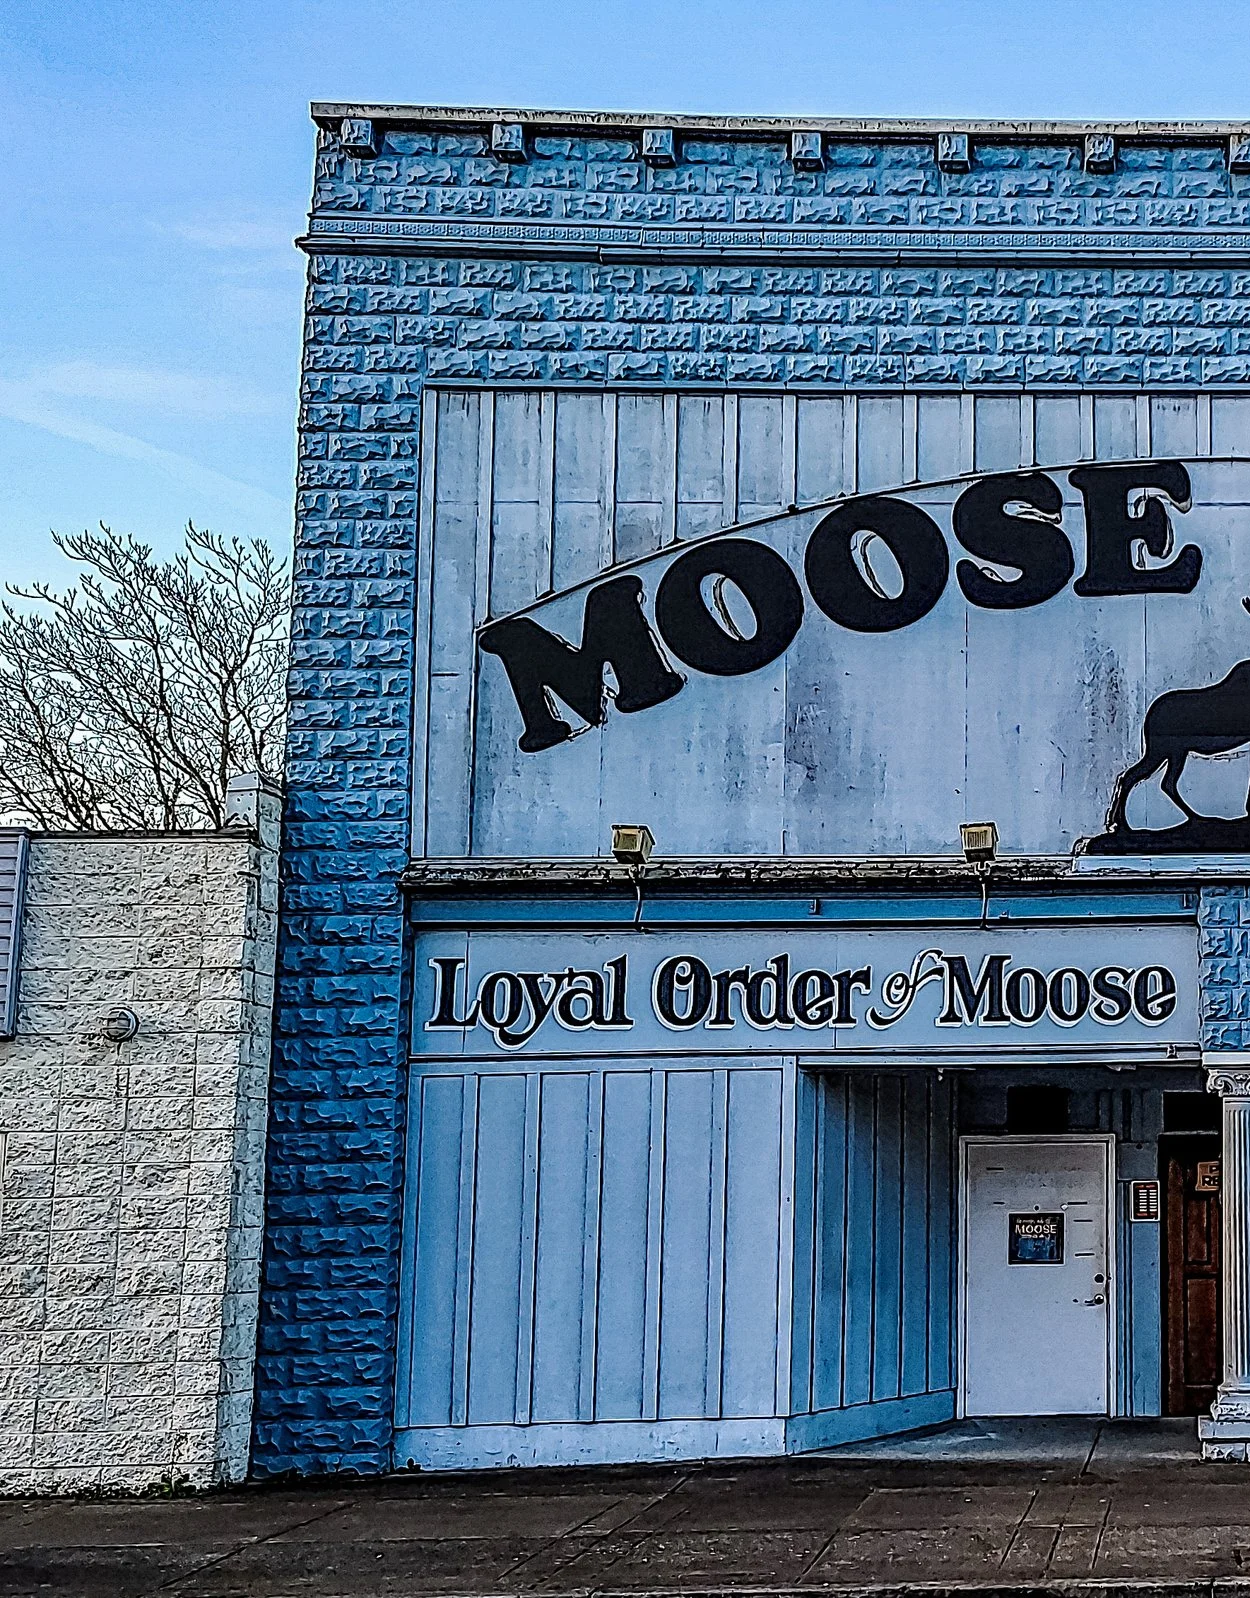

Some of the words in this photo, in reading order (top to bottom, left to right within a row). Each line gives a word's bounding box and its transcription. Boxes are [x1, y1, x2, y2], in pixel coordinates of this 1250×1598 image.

[479, 461, 1203, 753] MOOSE
[427, 953, 633, 1050] Loyal
[651, 953, 871, 1030] Order
[865, 947, 944, 1031] of
[935, 953, 1178, 1029] Moose
[1015, 1224, 1058, 1235] MOOSE
